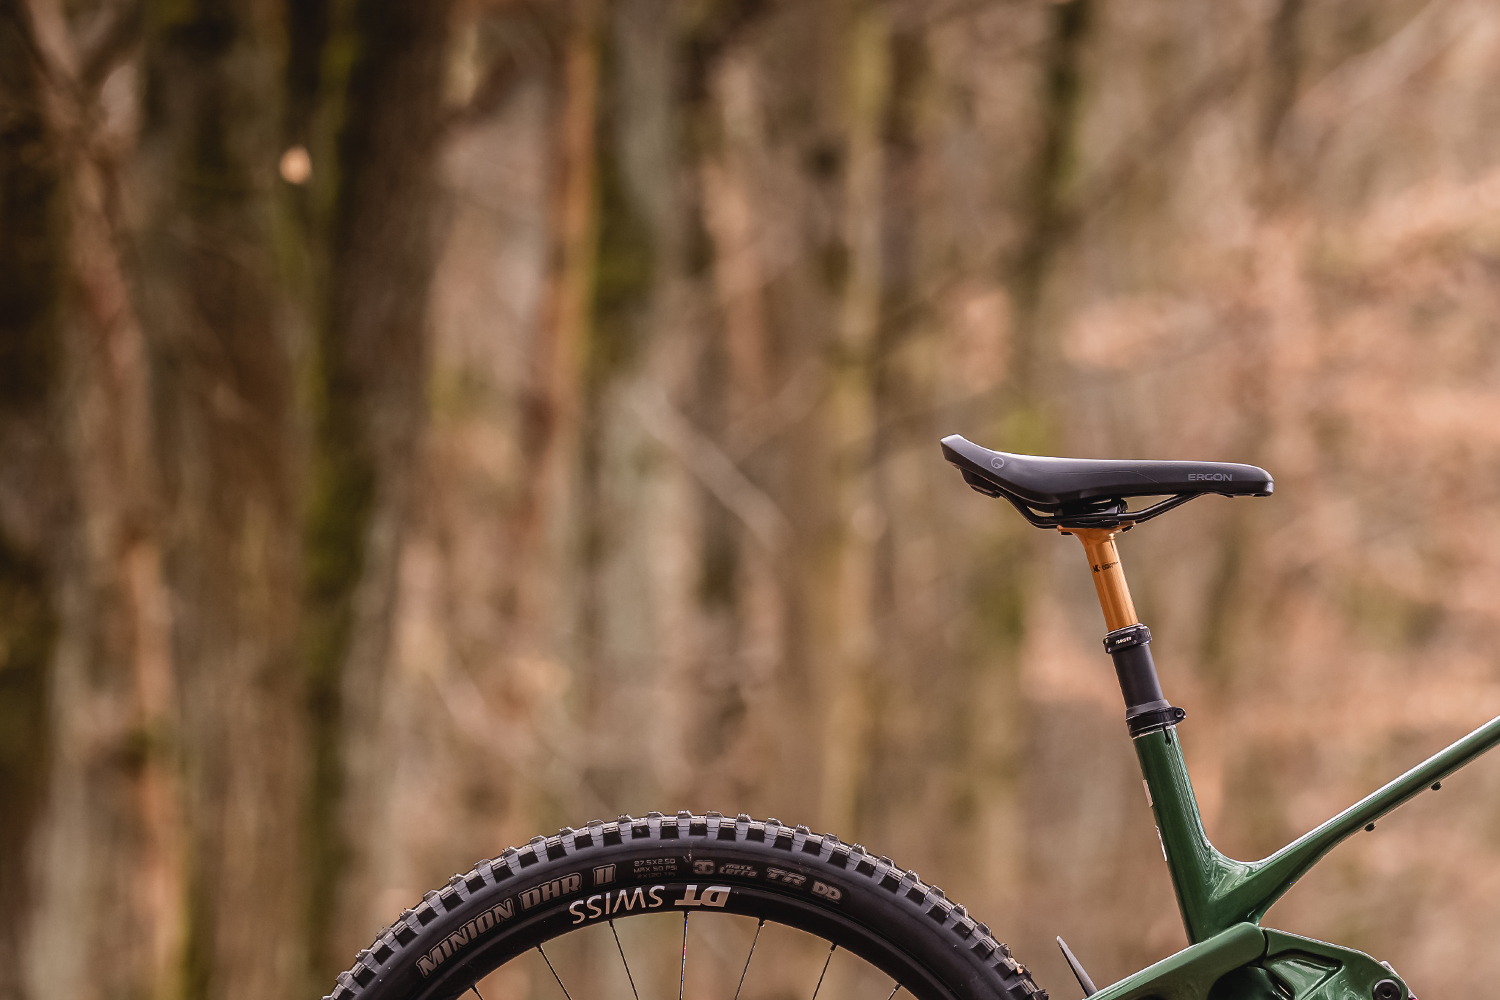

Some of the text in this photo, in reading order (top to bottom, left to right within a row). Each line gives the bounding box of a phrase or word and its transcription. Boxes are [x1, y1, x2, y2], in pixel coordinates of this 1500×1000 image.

[1188, 472, 1233, 482] ERGON
[568, 884, 731, 925] DT SWISS
[811, 880, 843, 902] DD
[416, 863, 616, 979] MINION DHR II
